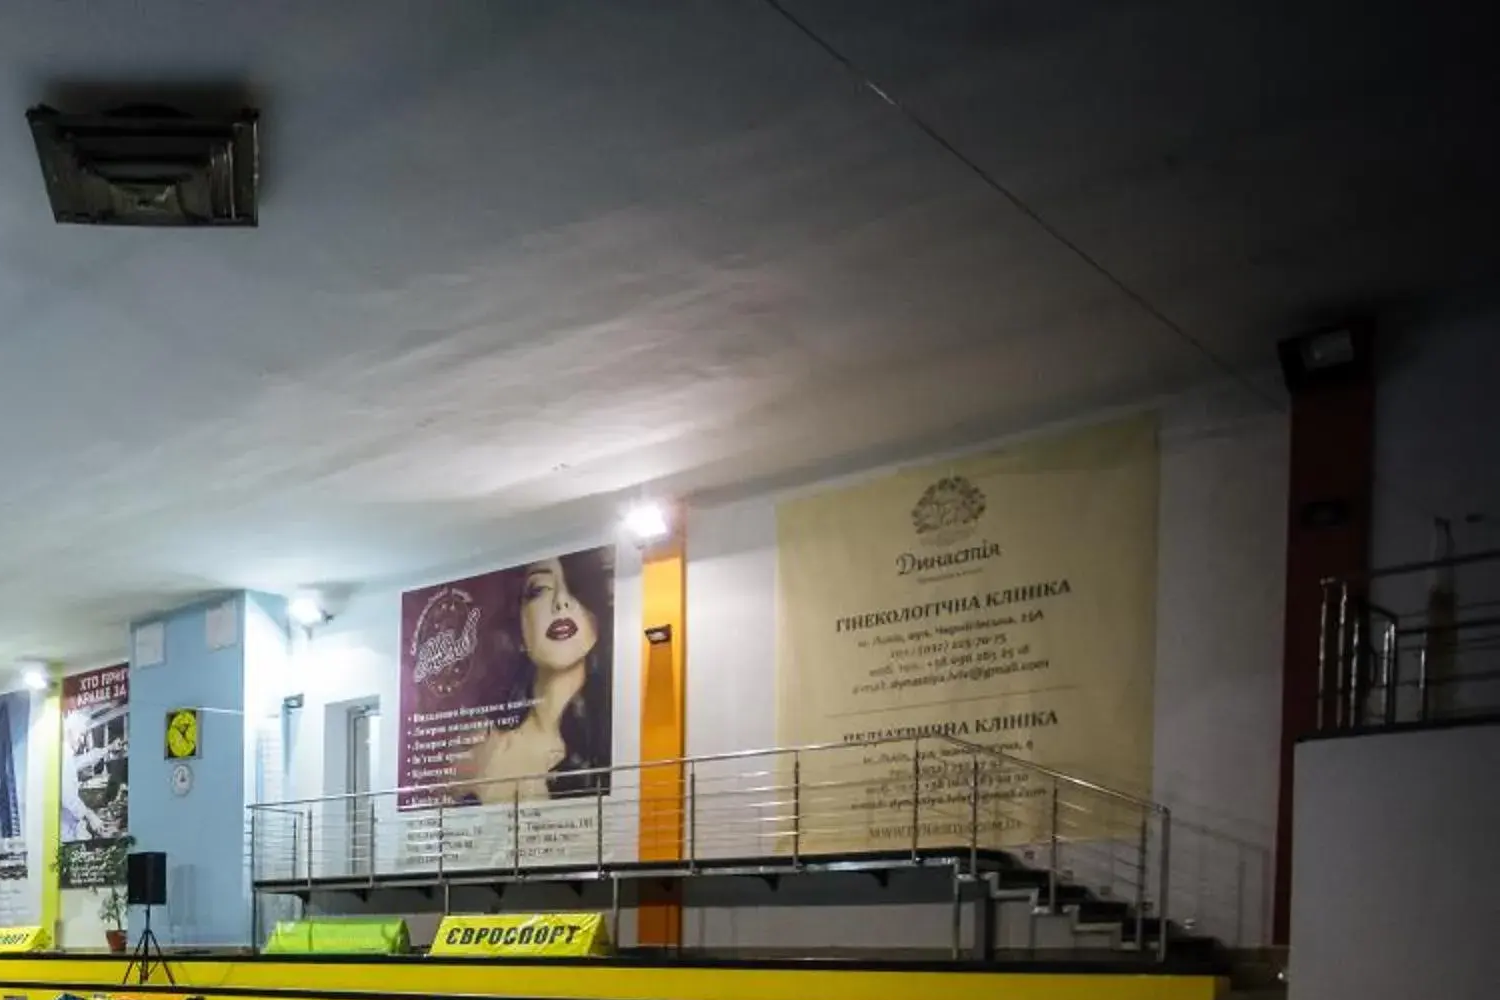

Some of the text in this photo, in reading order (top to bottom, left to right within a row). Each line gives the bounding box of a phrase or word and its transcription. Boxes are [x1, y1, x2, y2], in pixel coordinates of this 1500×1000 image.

[836, 579, 1073, 633] ГІНЕКОЛОГІЧНА КЛІНІКА
[80, 676, 99, 692] ХТО
[975, 710, 1058, 734] КЛІНІКА
